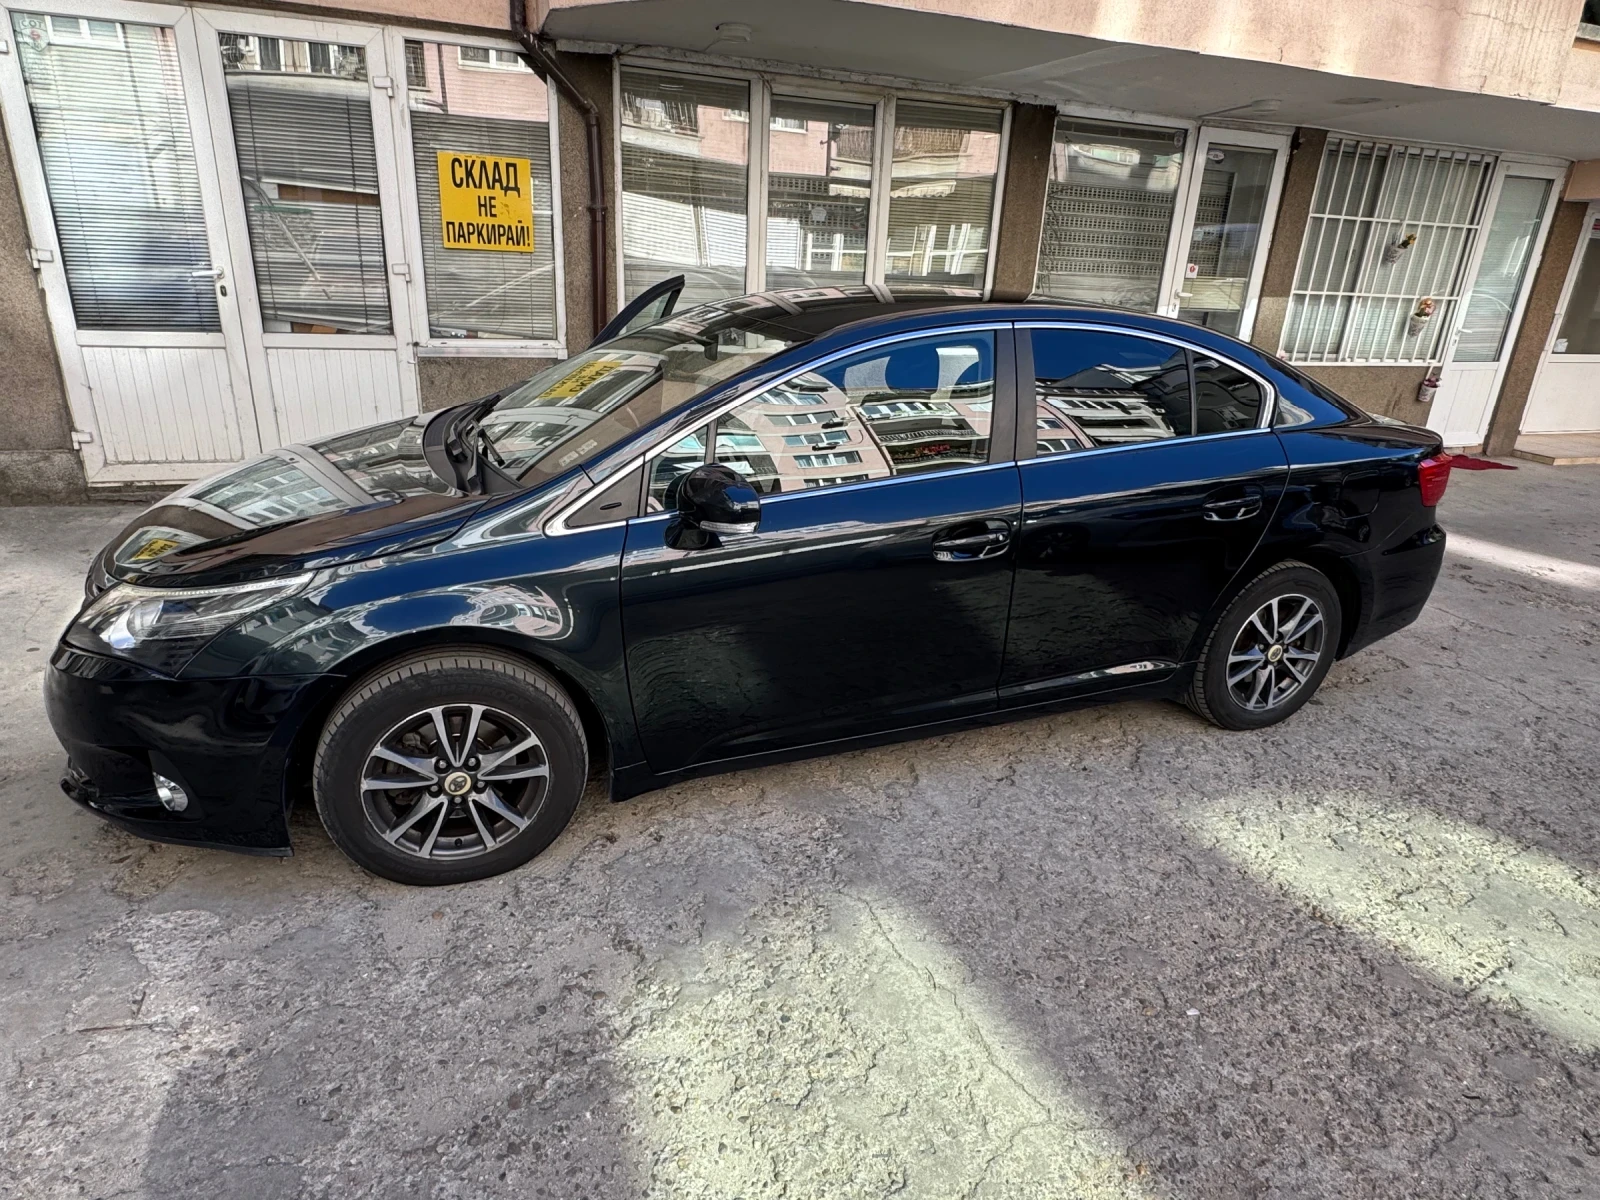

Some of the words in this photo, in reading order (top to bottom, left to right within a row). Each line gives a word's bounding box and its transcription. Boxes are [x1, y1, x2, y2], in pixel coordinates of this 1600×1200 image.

[451, 157, 521, 198] СКЛАД
[477, 195, 497, 218] НЕ
[446, 220, 530, 247] ПАРКИРАЙ!
